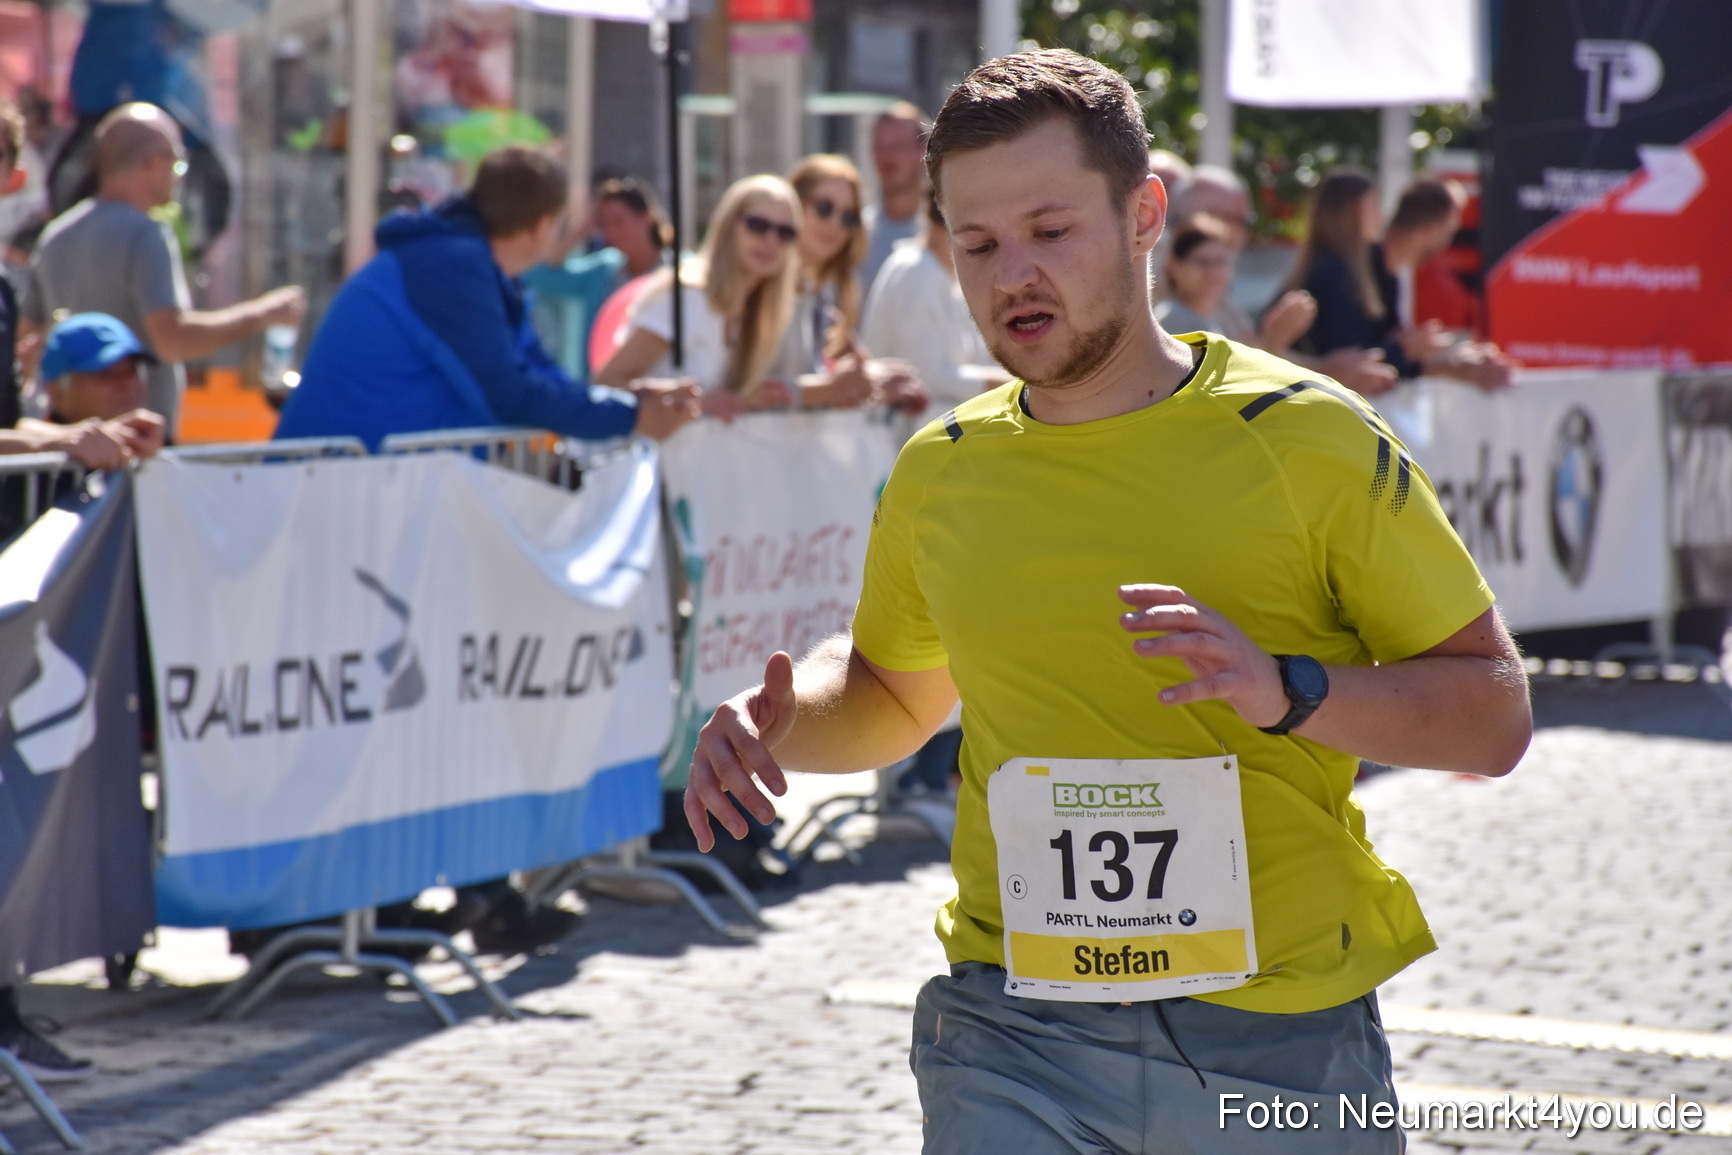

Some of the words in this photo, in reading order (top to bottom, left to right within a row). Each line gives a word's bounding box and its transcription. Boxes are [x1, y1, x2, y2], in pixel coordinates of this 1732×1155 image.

[1053, 783, 1163, 808] BOCK
[1054, 809, 1085, 818] inspired
[1087, 810, 1097, 819] by
[1127, 809, 1166, 818] concepts
[1050, 829, 1178, 902] 137
[1014, 880, 1021, 894] C
[1046, 912, 1094, 927] PARTL
[1097, 912, 1172, 928] Neumarkt
[1074, 945, 1170, 976] Stefan
